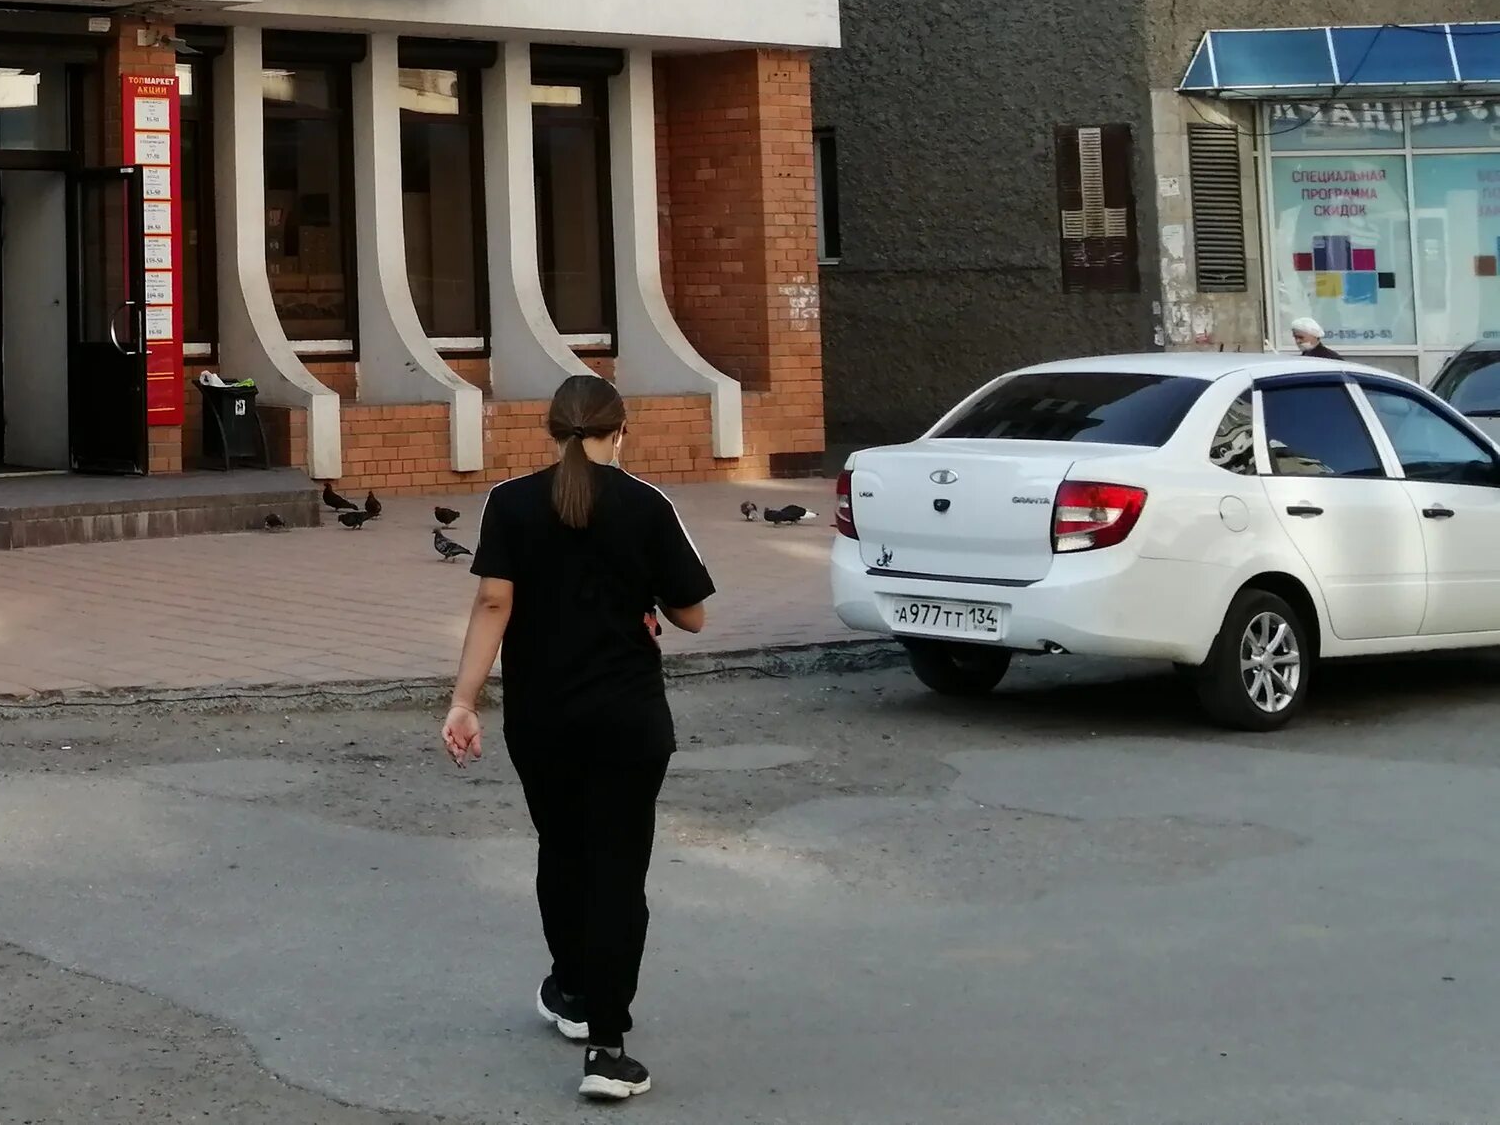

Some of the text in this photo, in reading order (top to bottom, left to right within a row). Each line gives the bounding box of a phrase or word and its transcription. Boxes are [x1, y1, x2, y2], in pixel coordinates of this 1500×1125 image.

[128, 76, 176, 86] ТОПМАРКЕТ
[137, 86, 168, 95] АКЦИИ
[1291, 169, 1387, 183] СПЕЦИАЛЬНАЯ
[1301, 187, 1378, 200] ПРОГРАММА
[1313, 204, 1367, 218] СКИДОК
[1011, 496, 1050, 504] GRANTA
[968, 607, 995, 625] 134
